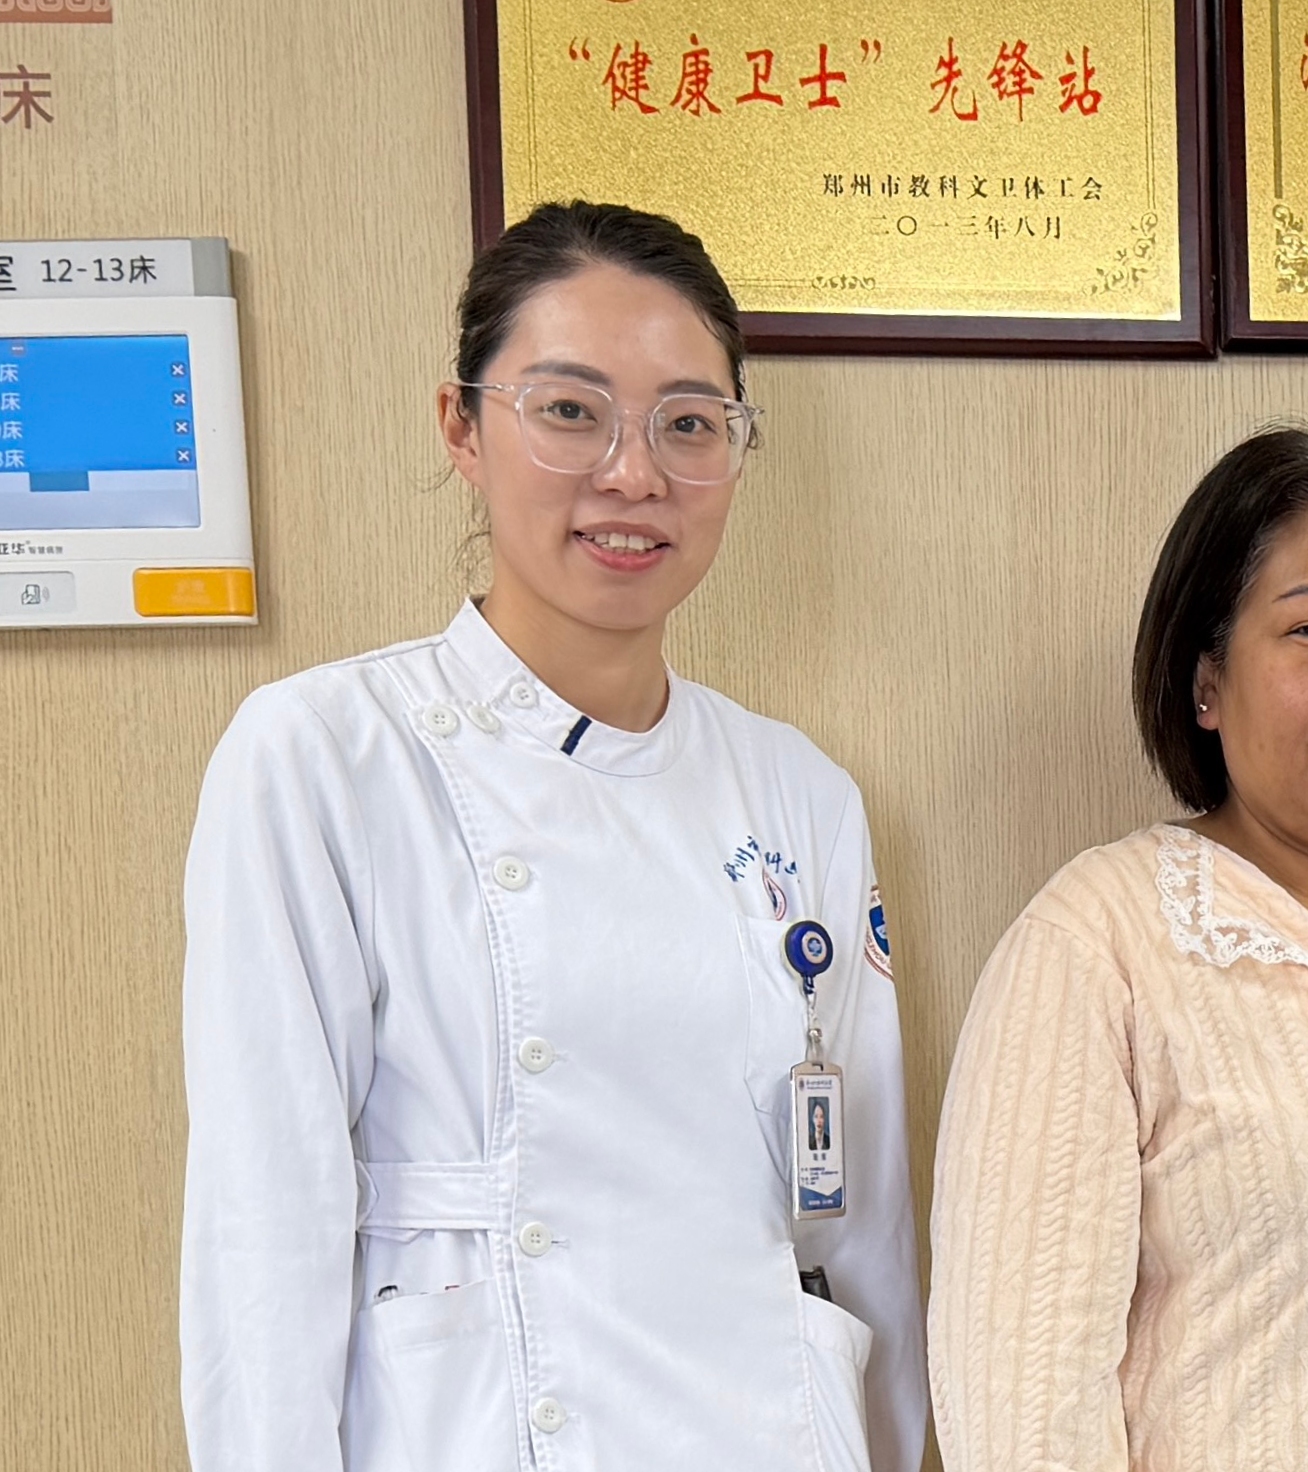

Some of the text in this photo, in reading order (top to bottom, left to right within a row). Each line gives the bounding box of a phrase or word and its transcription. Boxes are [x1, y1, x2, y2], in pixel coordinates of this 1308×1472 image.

[821, 172, 1105, 203] 郑州市教科文卫体工会
[40, 254, 157, 284] 12-13床
